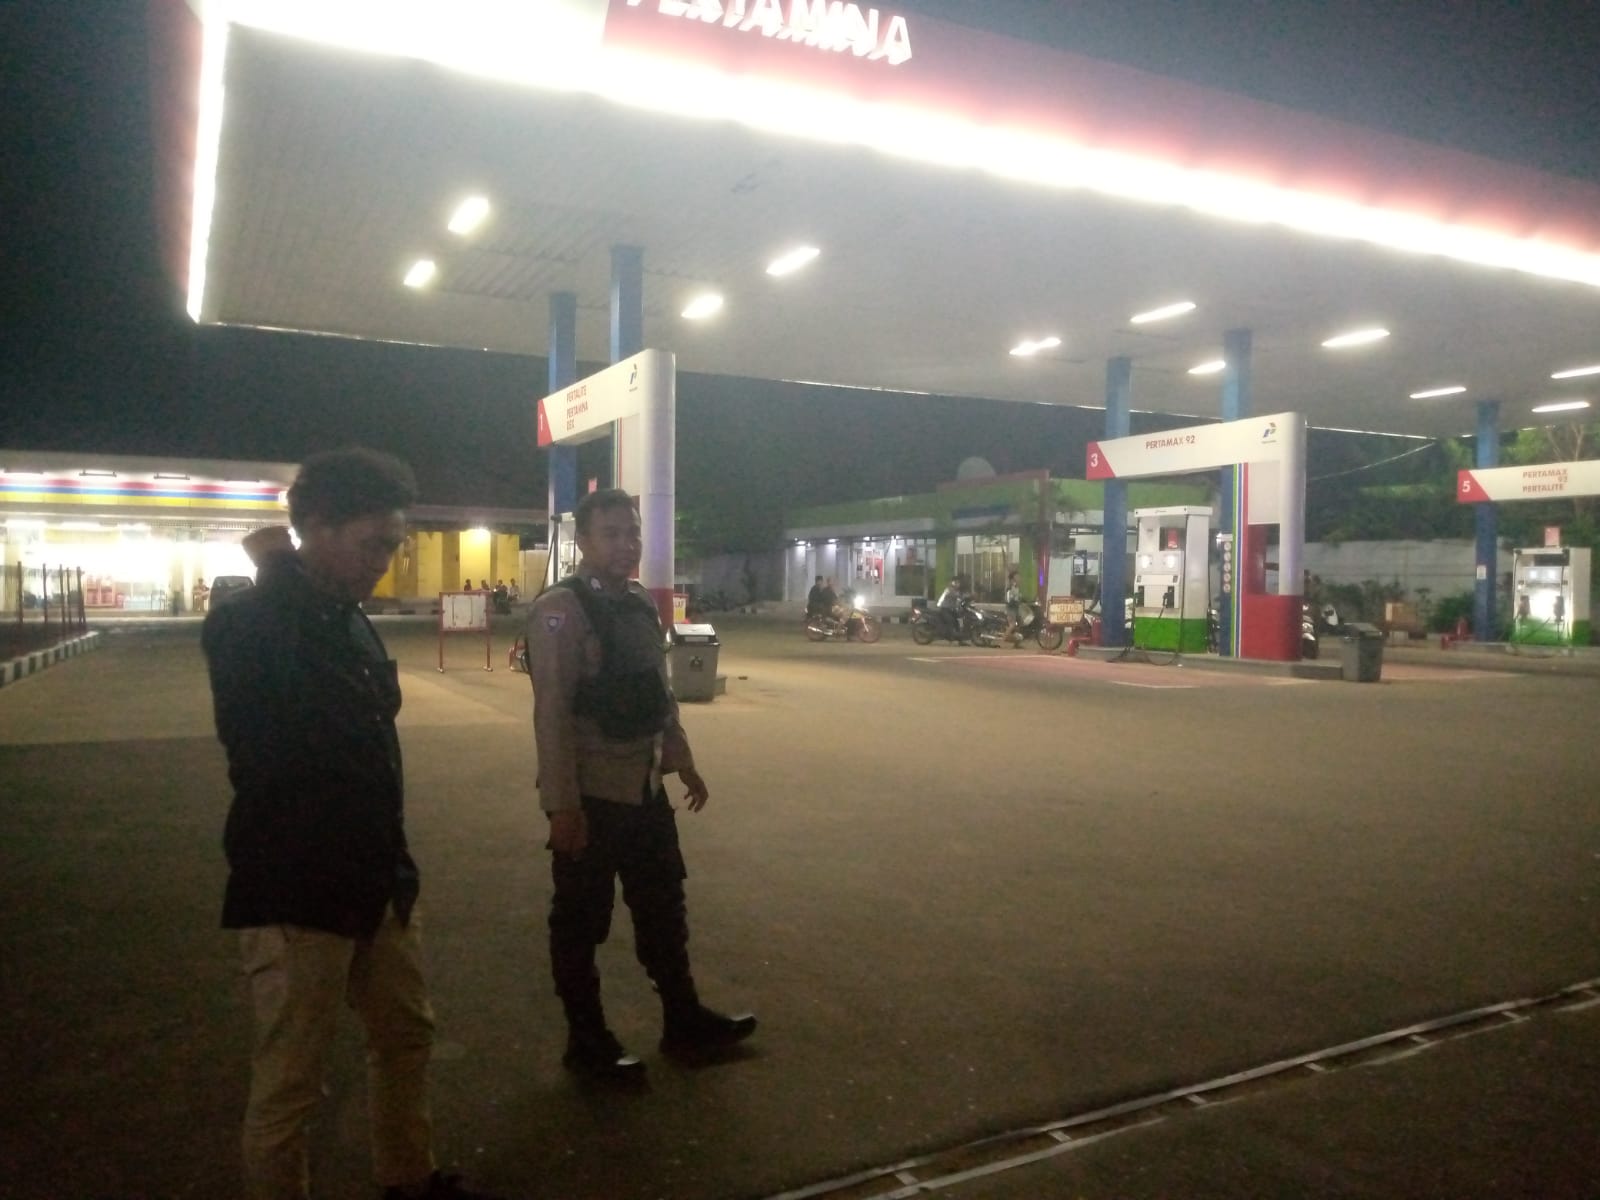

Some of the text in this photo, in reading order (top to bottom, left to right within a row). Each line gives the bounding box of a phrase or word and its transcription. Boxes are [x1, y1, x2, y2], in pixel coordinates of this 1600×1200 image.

[626, 0, 912, 65] RTAMINA
[1145, 435, 1196, 450] PERTAMAX 92
[1090, 453, 1099, 468] 3
[1522, 469, 1568, 479] PERTAMAX
[1462, 480, 1472, 493] 5
